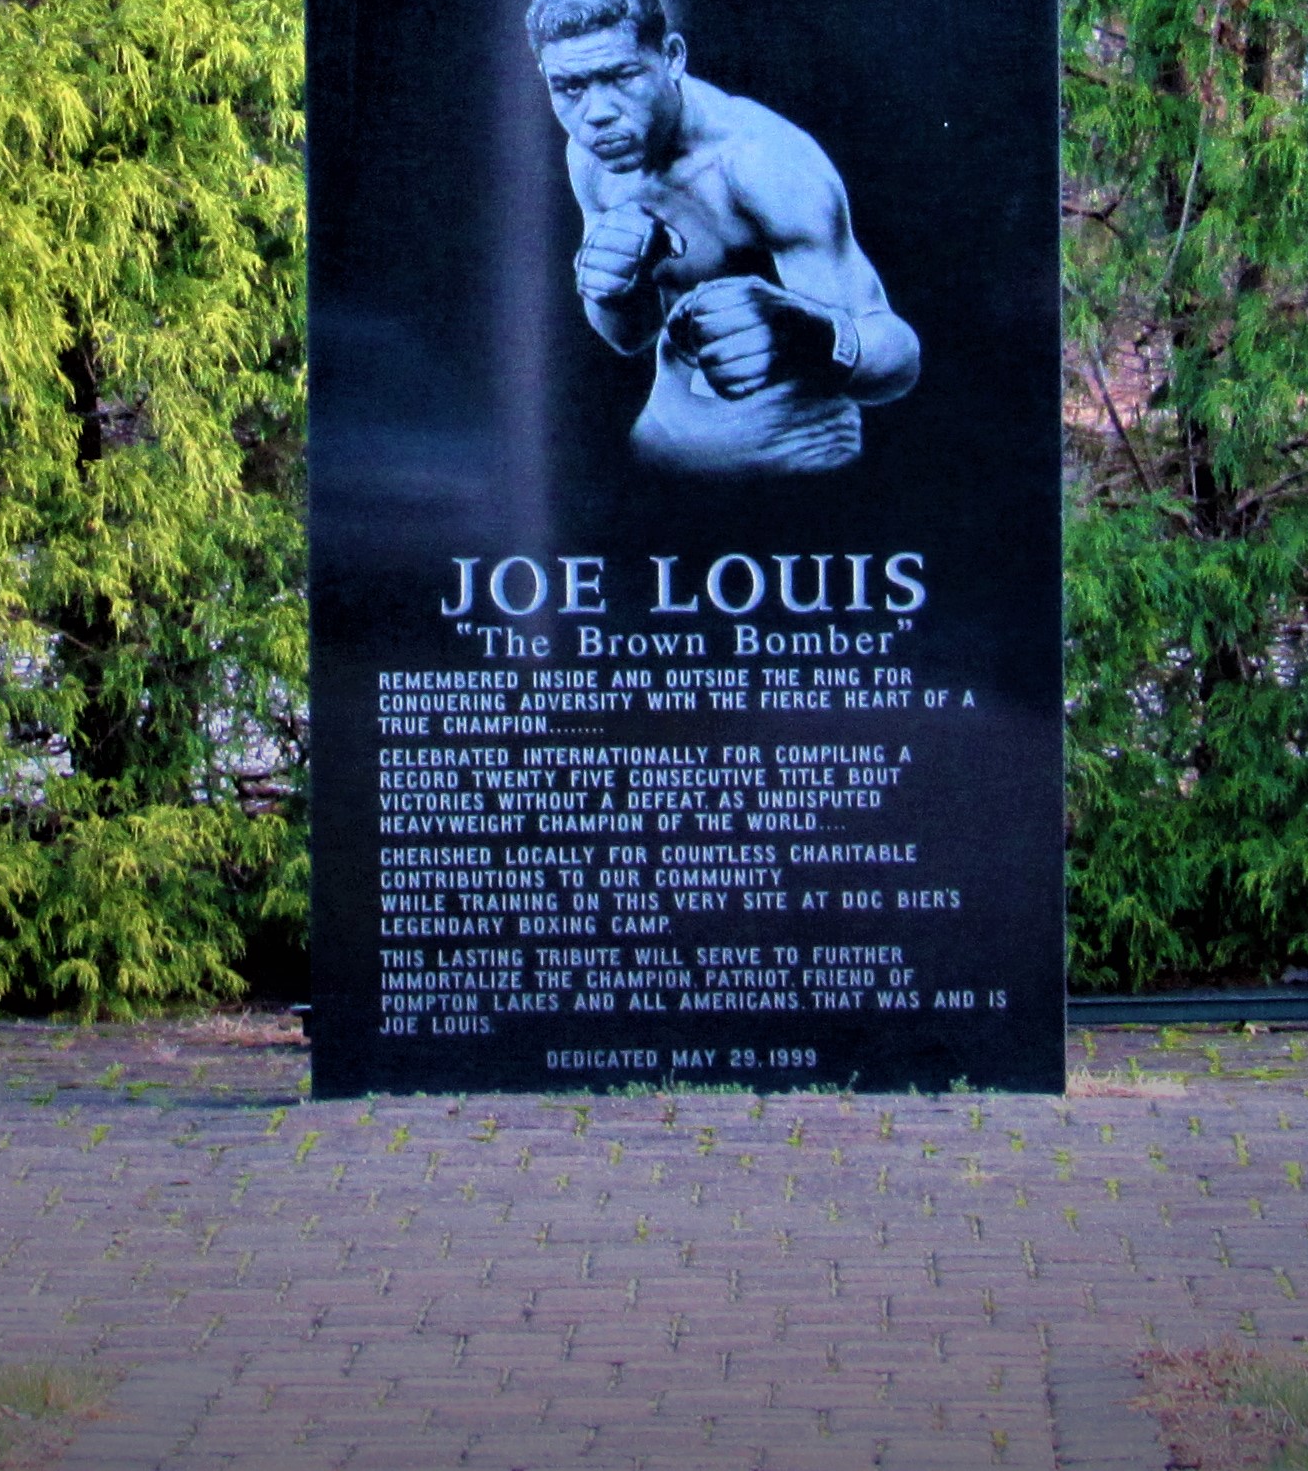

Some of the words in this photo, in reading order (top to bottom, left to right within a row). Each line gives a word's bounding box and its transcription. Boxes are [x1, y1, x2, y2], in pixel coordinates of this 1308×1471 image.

[440, 554, 607, 616] JOE
[648, 551, 928, 616] LOUIS
[455, 621, 552, 658] “The
[577, 625, 707, 657] Brown
[733, 618, 914, 656] Bomber”
[378, 670, 519, 691] REMEMBERED
[532, 669, 598, 690] INSIDE
[611, 669, 652, 689] AND
[665, 668, 750, 689] OUTSIDE
[761, 667, 800, 688] THE
[813, 667, 861, 687] RING
[873, 666, 913, 687] FOR
[379, 693, 506, 713] CONQUERING
[519, 692, 633, 712] ADVERSITY
[647, 691, 697, 711] WITH
[708, 691, 747, 710] THE
[760, 690, 832, 710] FIERCE
[844, 689, 912, 709] HEART
[923, 689, 949, 708] OF
[962, 689, 975, 708] A
[377, 716, 430, 736] TRUE
[379, 747, 509, 768] CELEBRATED
[523, 745, 708, 767] INTERNATIONALLY
[722, 745, 762, 765] FOR
[775, 744, 886, 765] COMPILING
[898, 743, 912, 764] A
[379, 770, 459, 790] RECORD
[471, 769, 556, 789] TWENTY
[570, 769, 615, 788] FIVE
[629, 768, 766, 788] CONSECUTIVE
[778, 767, 835, 787] TITLE
[848, 766, 902, 786] BOUT
[379, 792, 485, 812] VICTORIES
[498, 791, 588, 811] WITHOUT
[600, 791, 614, 810] A
[718, 790, 745, 809] AS
[757, 789, 882, 809] UNDISPUTED
[379, 814, 526, 835] HEAVYWEIGHT
[538, 813, 644, 834] CHAMPION
[657, 812, 683, 833] OF
[694, 812, 733, 832] THE
[380, 846, 492, 867] CHERISHED
[505, 845, 595, 866] LOCALLY
[608, 845, 648, 865] FOR
[661, 844, 777, 865] COUNTLESS
[790, 842, 917, 863] CHARITABLE
[380, 869, 545, 890] CONTRIBUTIONS
[558, 868, 585, 888] TO
[599, 868, 641, 888] OUR
[654, 867, 782, 888] COMMUNITY
[380, 893, 445, 913] WHILE
[459, 892, 558, 912] TRAINING
[572, 892, 600, 911] ON
[613, 892, 660, 911] THIS
[673, 891, 728, 910] VERY
[743, 890, 788, 910] SITE
[801, 890, 829, 909] AT
[841, 890, 883, 909] DOC
[897, 889, 961, 909] BIER'S
[380, 916, 504, 937] LEGENDARY
[518, 915, 597, 936] BOXING
[611, 915, 670, 935] CAMP.
[380, 949, 425, 969] THIS
[437, 948, 524, 969] LASTING
[535, 947, 621, 968] TRIBUTE
[634, 946, 684, 967] WILL
[696, 946, 761, 966] SERVE
[773, 945, 799, 966] TO
[812, 944, 904, 965] FURTHER
[381, 971, 522, 991] IMMORTALIZE
[534, 970, 573, 990] THE
[802, 968, 876, 987] FRIEND
[889, 967, 914, 987] OF
[381, 993, 479, 1014] POMPTON
[493, 992, 559, 1013] LAKES
[574, 992, 615, 1012] AND
[628, 992, 667, 1012] ALL
[811, 990, 864, 1010] THAT
[876, 989, 920, 1010] WAS
[934, 989, 975, 1009] AND
[989, 989, 1007, 1009] IS
[379, 1017, 419, 1036] JOE
[546, 1051, 658, 1070] DEDICATED
[671, 1050, 716, 1068] MAY
